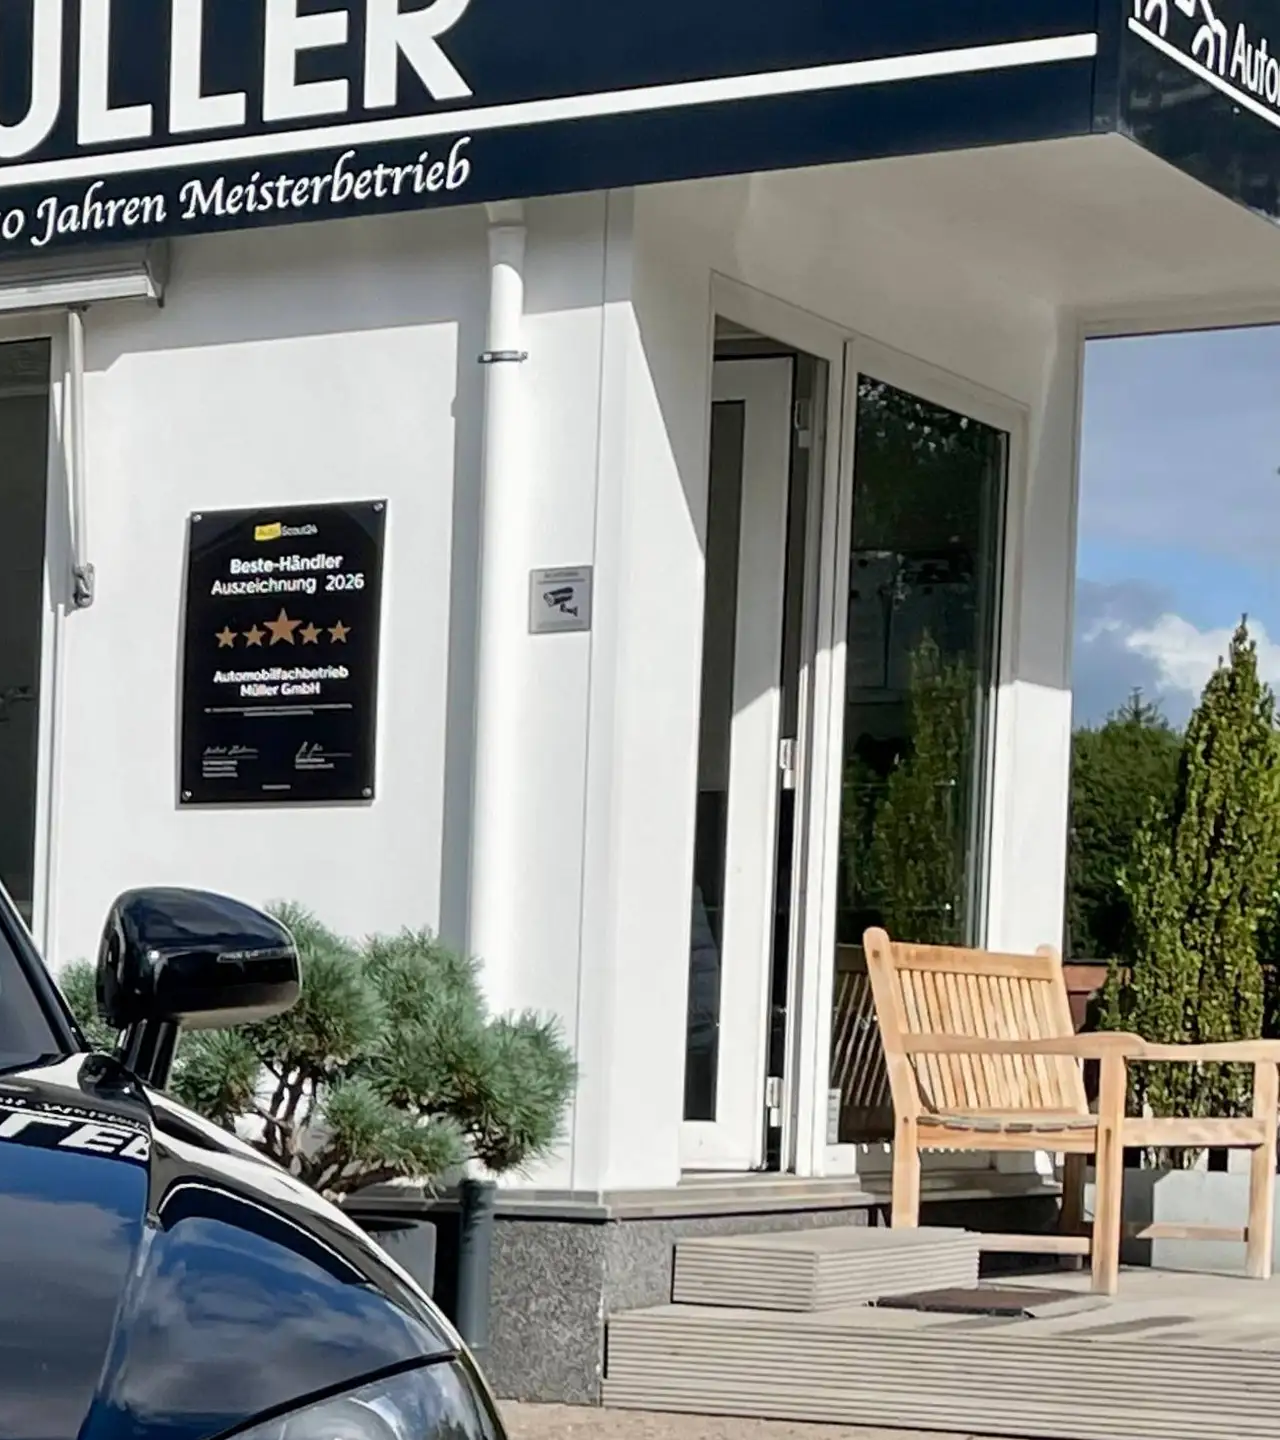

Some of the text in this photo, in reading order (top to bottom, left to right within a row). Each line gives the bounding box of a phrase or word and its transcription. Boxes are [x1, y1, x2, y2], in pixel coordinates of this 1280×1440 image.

[1230, 22, 1280, 107] Auto
[30, 182, 166, 247] Jahren
[179, 137, 472, 219] Meisterbetrieb
[230, 553, 343, 574] Beste-Händler
[211, 573, 365, 595] Auszeichnung 2026
[213, 665, 349, 683] Automobilfachbetrieb
[240, 682, 320, 697] Müller GmbH
